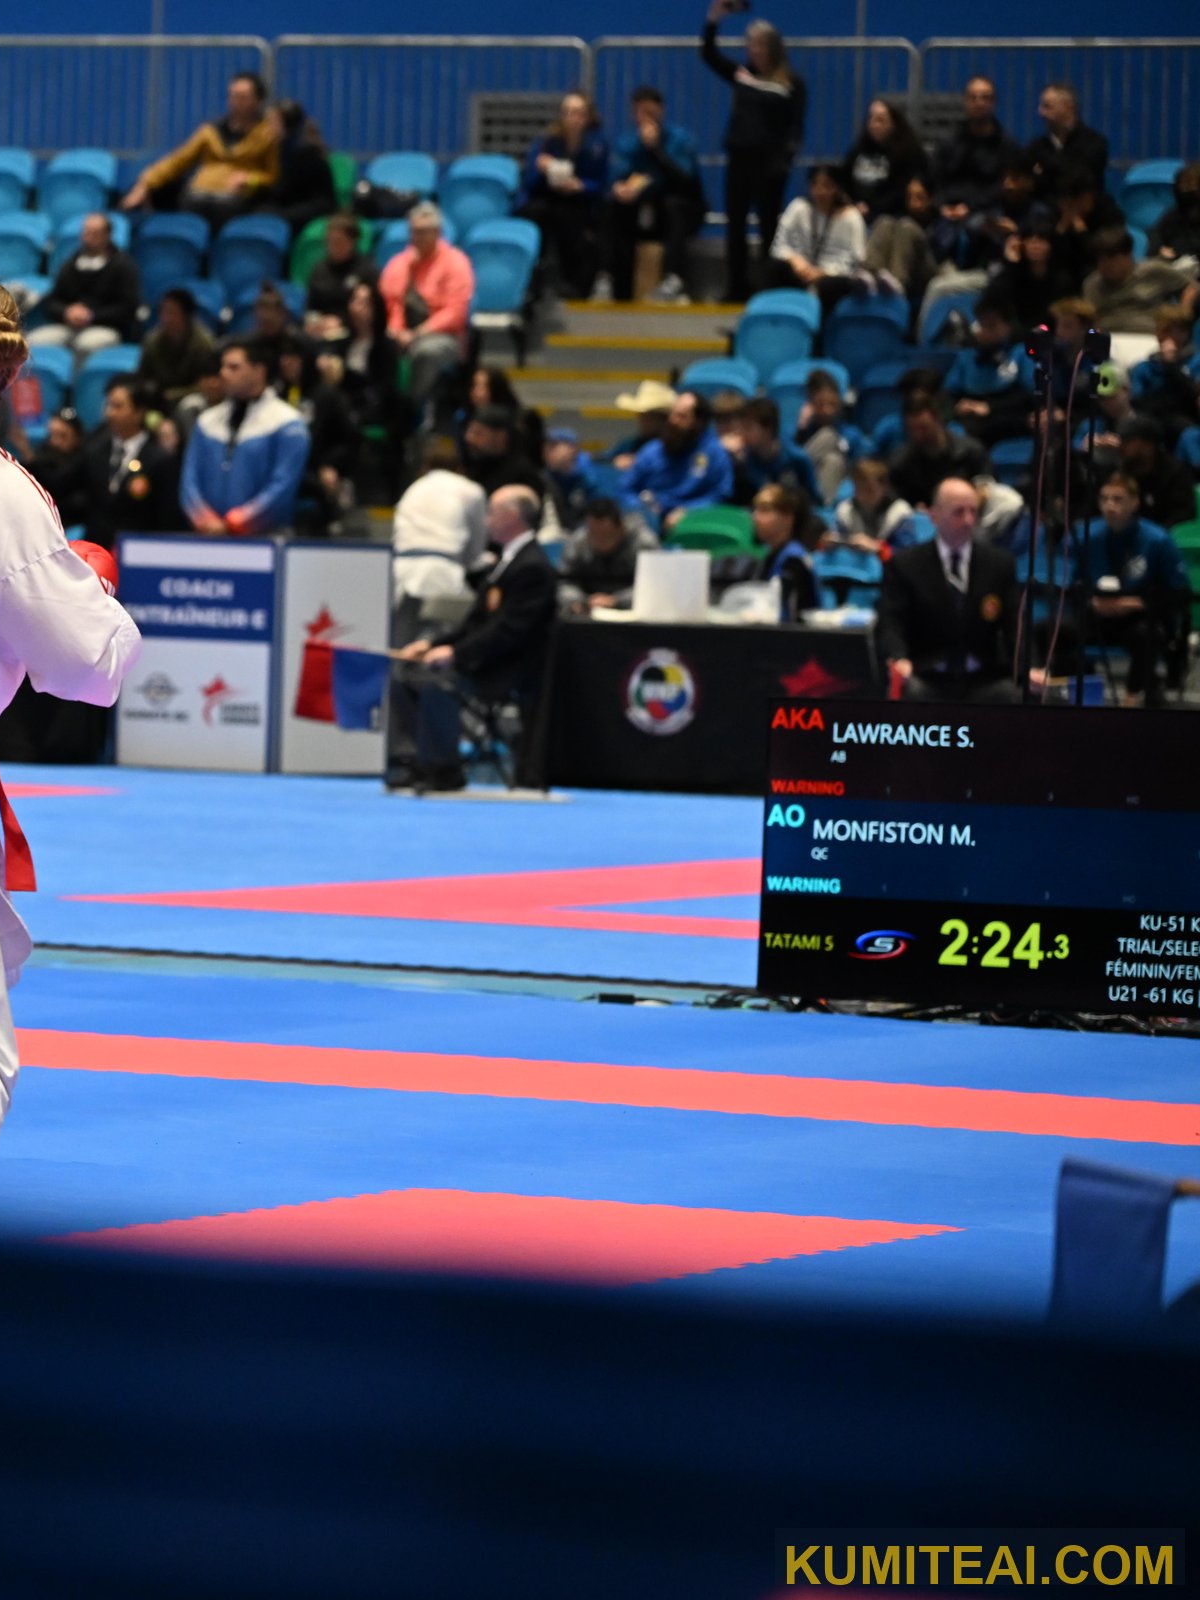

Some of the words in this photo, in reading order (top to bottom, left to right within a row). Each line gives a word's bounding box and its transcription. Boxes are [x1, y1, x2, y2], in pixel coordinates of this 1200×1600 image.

[159, 577, 234, 600] COACH
[771, 707, 824, 730] AKA
[832, 721, 951, 747] LAWRANCE
[956, 725, 975, 748] S.
[830, 749, 846, 763] AB
[771, 779, 845, 796] WARNING
[767, 803, 805, 828] AO
[812, 818, 943, 846] MONFISTON
[950, 824, 976, 847] M.
[810, 847, 828, 861] QC
[767, 875, 841, 894] WARNING
[1140, 915, 1185, 932] KU-51
[764, 932, 820, 951] TATAMI
[824, 935, 834, 951] 5
[938, 919, 1070, 970] 2:24.3
[1117, 937, 1200, 957] TRIAL/SELE
[1108, 985, 1137, 1002] U21
[1142, 986, 1167, 1004] -61
[1172, 988, 1194, 1005] KG
